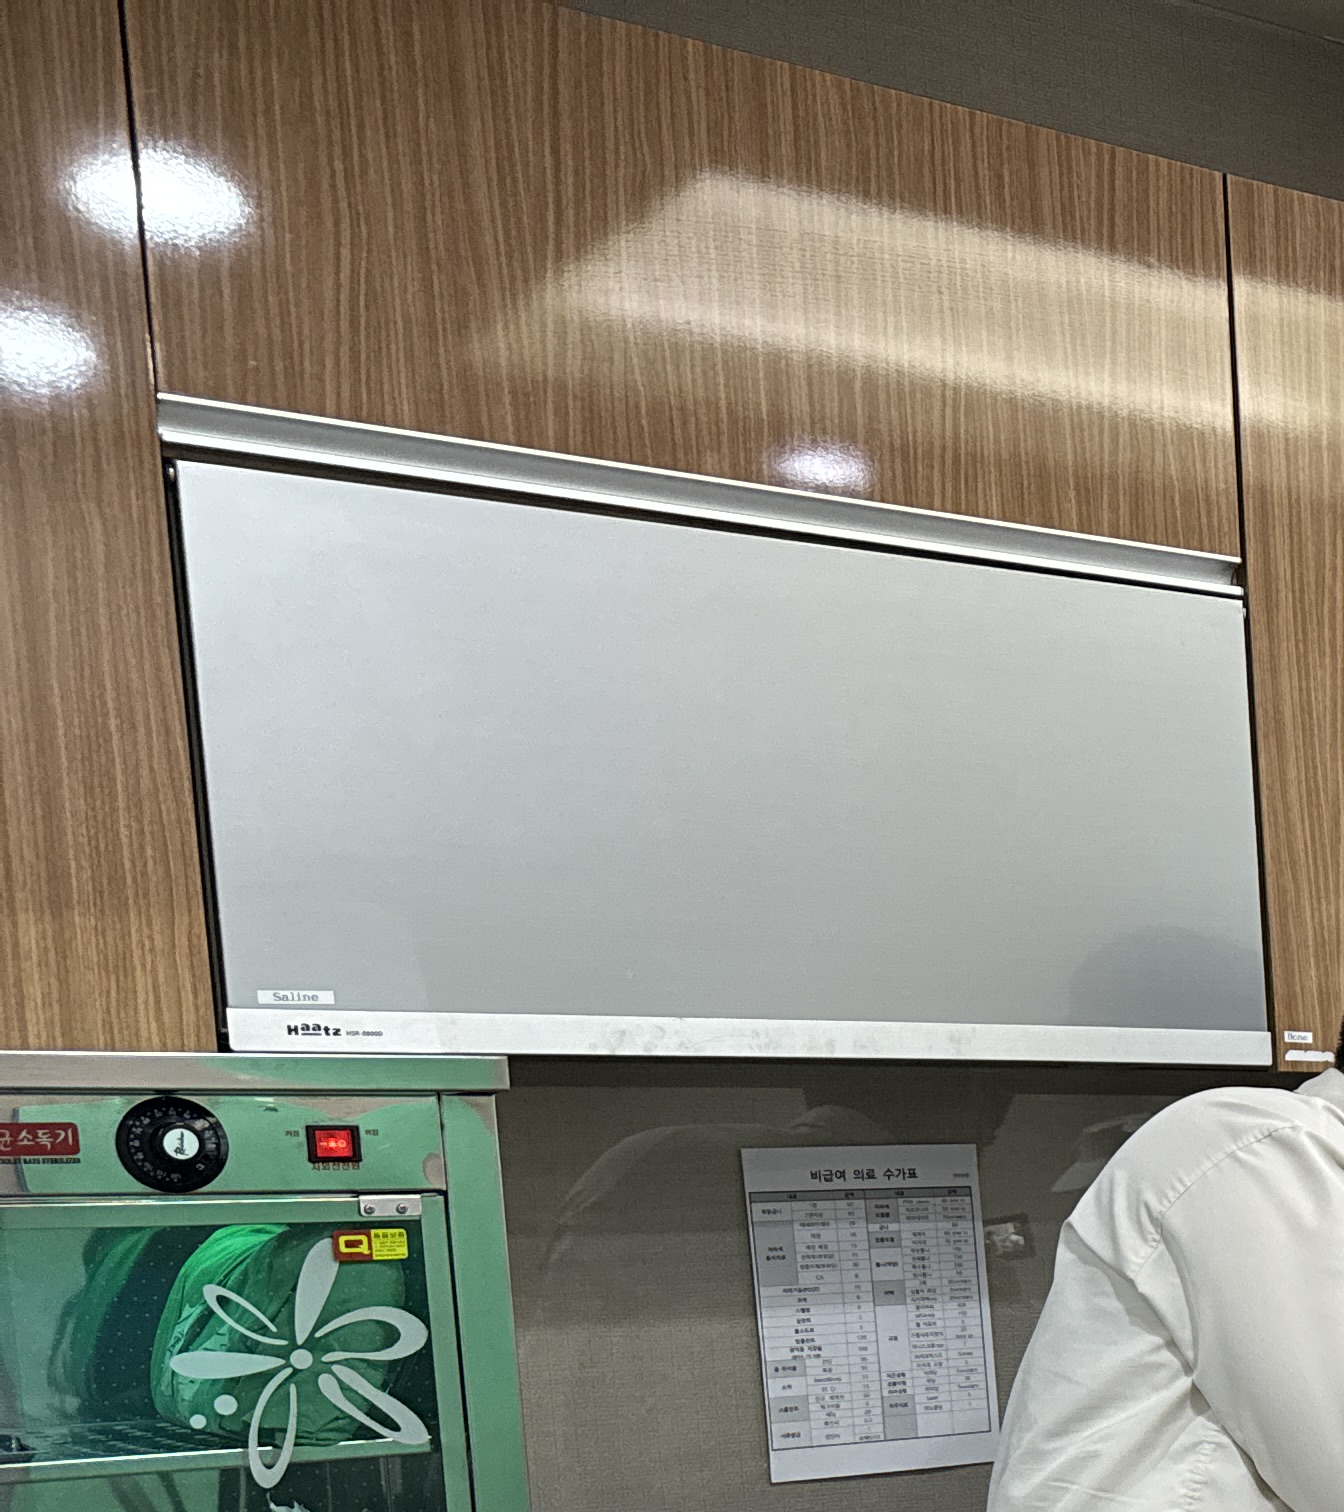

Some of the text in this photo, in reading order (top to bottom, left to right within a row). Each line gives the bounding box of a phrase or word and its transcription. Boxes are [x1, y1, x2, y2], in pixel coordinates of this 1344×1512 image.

[272, 991, 319, 1002] Saline
[287, 1023, 342, 1036] Haatz
[809, 1167, 919, 1183] 비급여 의료 수가표
